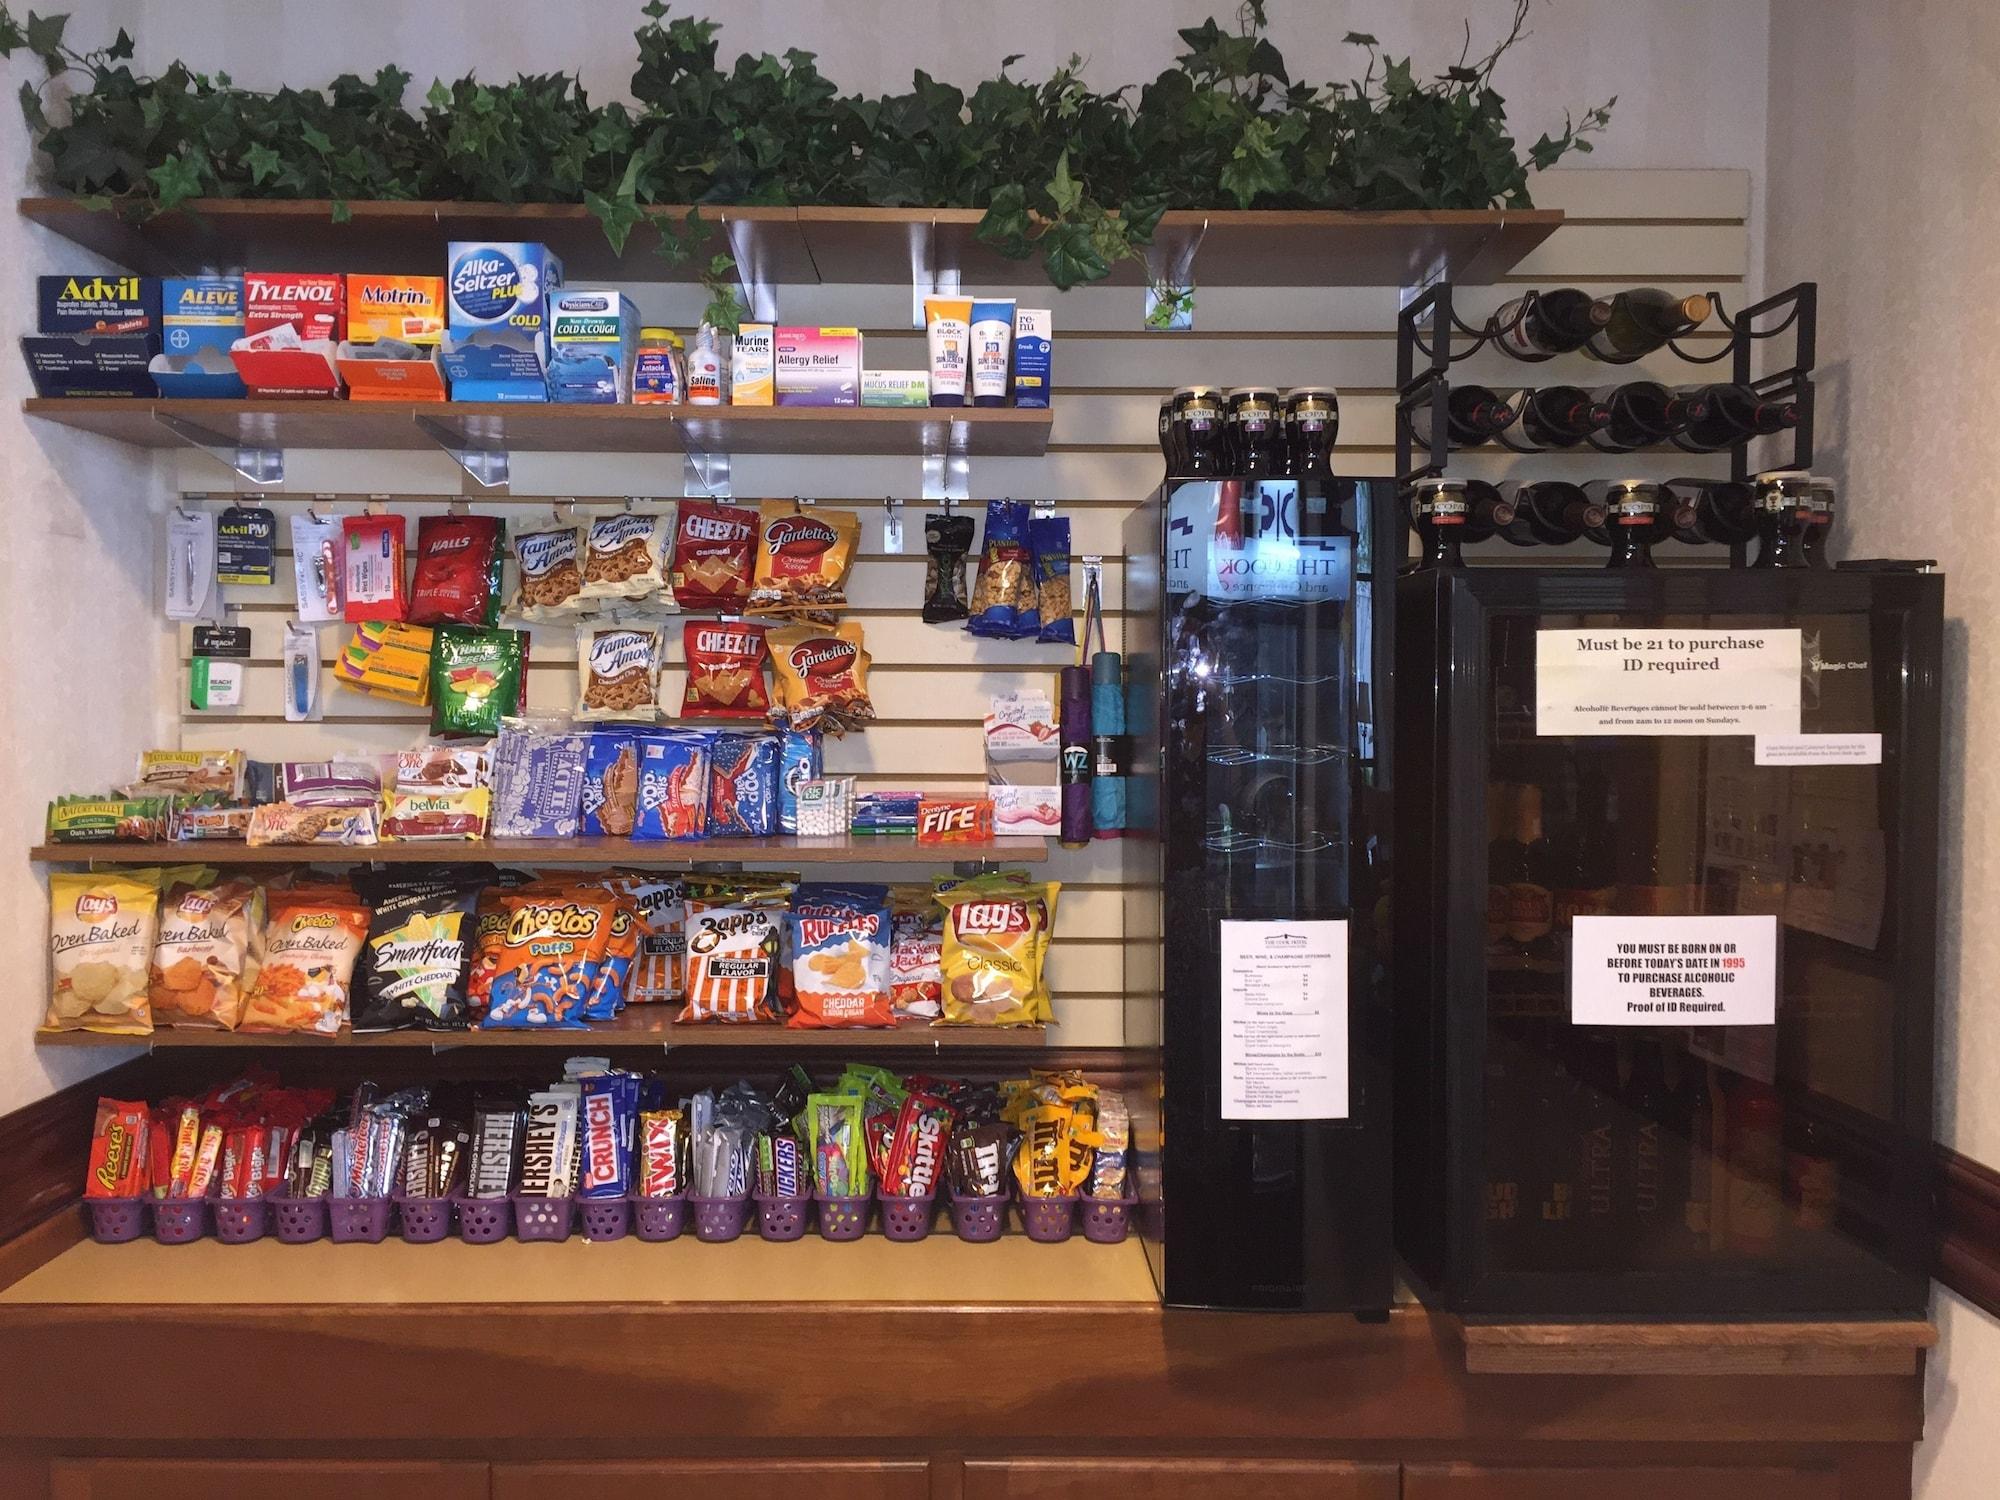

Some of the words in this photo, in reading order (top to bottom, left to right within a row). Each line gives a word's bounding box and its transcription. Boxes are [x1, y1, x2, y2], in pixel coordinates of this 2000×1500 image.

[457, 259, 504, 278] Alka-
[58, 277, 139, 301] Advil
[247, 280, 334, 302] TYLENOL
[453, 272, 515, 294] Seltzer
[179, 288, 238, 305] ALEVE
[361, 285, 425, 304] Motrin
[269, 312, 303, 320] Strength
[509, 315, 541, 326] COLD
[558, 325, 580, 334] COLD
[580, 325, 586, 334] &
[588, 325, 616, 334] COUGH
[735, 336, 769, 347] Murine
[986, 343, 999, 351] 30
[642, 364, 665, 372] Antacid
[778, 355, 810, 367] Allergy
[812, 355, 839, 365] Relief
[690, 376, 716, 386] Saline
[864, 381, 886, 389] MUCUS
[889, 381, 909, 389] RELIEF
[1186, 410, 1214, 418] COPA
[1241, 410, 1270, 418] COPA
[1297, 411, 1326, 419] COPA
[1436, 503, 1464, 511] COPA
[1625, 502, 1654, 511] COPA
[219, 524, 248, 535] Advil
[248, 523, 269, 537] PM
[590, 514, 655, 539] Famous
[430, 536, 471, 553] HALLS
[518, 532, 577, 556] Famous
[600, 525, 651, 548] Amos
[765, 522, 838, 555] Gardetto's
[528, 542, 577, 570] Amos
[590, 633, 652, 661] Famous
[1577, 638, 1617, 651] Must
[1623, 637, 1642, 650] be
[1647, 641, 1662, 650] 21
[1668, 638, 1684, 650] to
[1689, 636, 1765, 653] purchase
[602, 648, 651, 673] Amos
[789, 641, 857, 678] Gardetto's
[1623, 658, 1643, 671] ID
[1648, 657, 1720, 674] required
[1820, 662, 1846, 671] Magic
[1847, 661, 1868, 669] Chef
[1574, 705, 1609, 713] Alcoholic
[1611, 705, 1649, 713] Beverages
[1707, 703, 1740, 711] between
[1706, 716, 1741, 724] Sundays.
[613, 742, 625, 751] 2
[1064, 753, 1089, 769] WZ
[553, 758, 572, 788] ACT
[669, 771, 681, 809] Strawberry
[805, 791, 821, 799] tac
[807, 785, 821, 793] tic
[410, 799, 450, 811] belVita
[551, 790, 567, 809] II
[921, 804, 951, 816] Dentyne
[923, 806, 976, 834] FIRE
[94, 829, 115, 838] Honey
[78, 895, 116, 914] Lay's
[179, 895, 215, 912] Lay's
[291, 912, 338, 933] Cheetos
[506, 905, 600, 946] Cheetos
[957, 902, 1026, 935] Lay's
[51, 932, 87, 948] Oven
[89, 919, 141, 943] Baked
[159, 929, 184, 942] ven
[186, 923, 228, 941] Baked
[270, 938, 301, 953] Oven
[302, 936, 348, 950] Baked
[530, 941, 575, 957] Puffs
[1617, 943, 1636, 954] YOU
[1638, 943, 1665, 954] MUST
[1668, 943, 1679, 954] BE
[1682, 943, 1707, 954] BORN
[1709, 943, 1721, 954] ON
[1724, 943, 1736, 953] OR
[375, 939, 465, 969] Smartfood
[719, 962, 759, 970] REGULAR
[968, 955, 1022, 971] Classic
[1607, 958, 1642, 968] BEFORE
[1645, 958, 1683, 969] TODAY'S
[1686, 958, 1708, 968] DATE
[1710, 958, 1720, 968] IN
[1722, 958, 1745, 968] 1995
[721, 969, 755, 977] FLAVOR
[1618, 973, 1630, 983] TO
[1632, 973, 1682, 983] PURCHASE
[1684, 973, 1735, 983] ALCOHOLIC
[386, 979, 413, 997] WHITE
[414, 971, 454, 985] CHEDDAR
[1649, 987, 1704, 998] BEVERAGES.
[823, 998, 864, 1008] CHEDDAR
[1627, 1002, 1653, 1012] Proof
[1655, 1002, 1665, 1012] of
[1667, 1002, 1677, 1012] ID
[1679, 1002, 1725, 1013] Required.
[590, 1097, 615, 1182] CRUNCH
[96, 1123, 125, 1190] Reese's
[467, 1153, 479, 1197] CHOCOLATE
